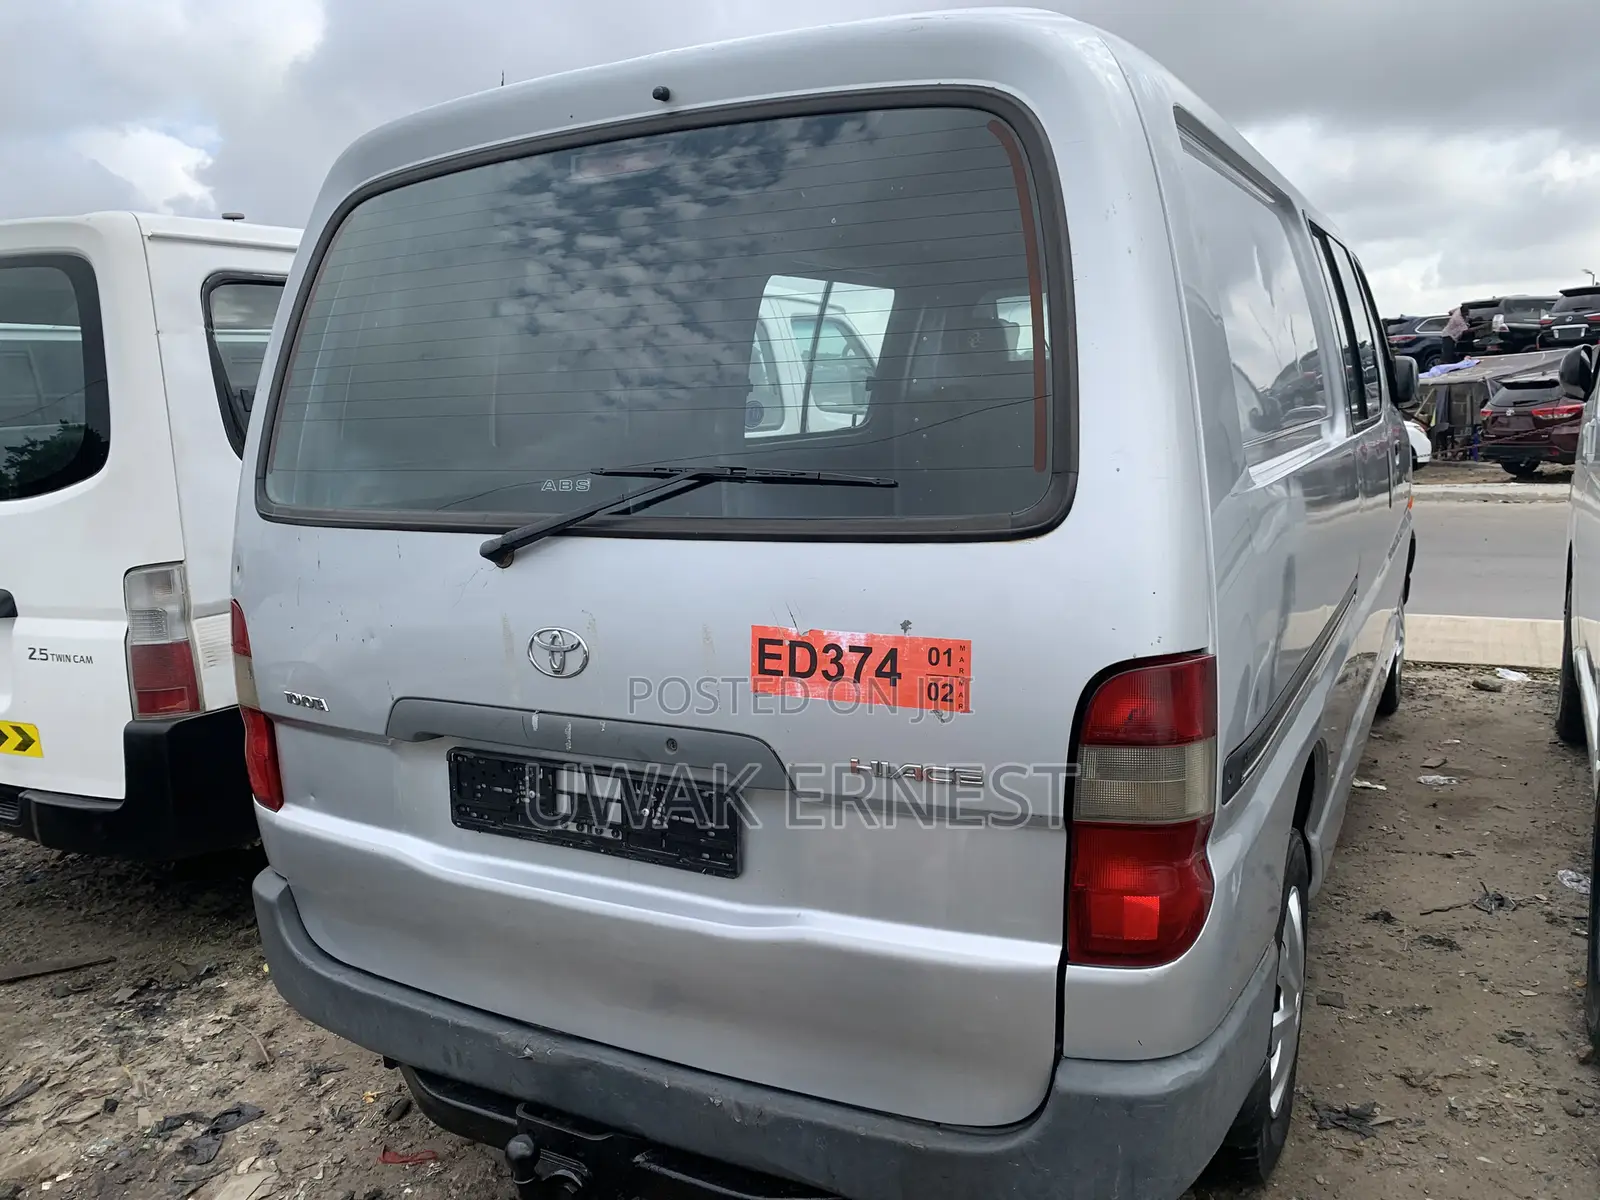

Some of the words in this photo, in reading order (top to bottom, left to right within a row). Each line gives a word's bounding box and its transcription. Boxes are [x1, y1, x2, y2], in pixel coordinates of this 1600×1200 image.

[541, 479, 590, 492] ABS
[28, 647, 49, 662] 2.5
[50, 653, 72, 663] TWIN
[73, 654, 94, 664] CAM
[757, 637, 902, 687] ED374
[927, 646, 952, 667] 01
[927, 682, 954, 703] 02
[850, 757, 984, 787] HIACE
